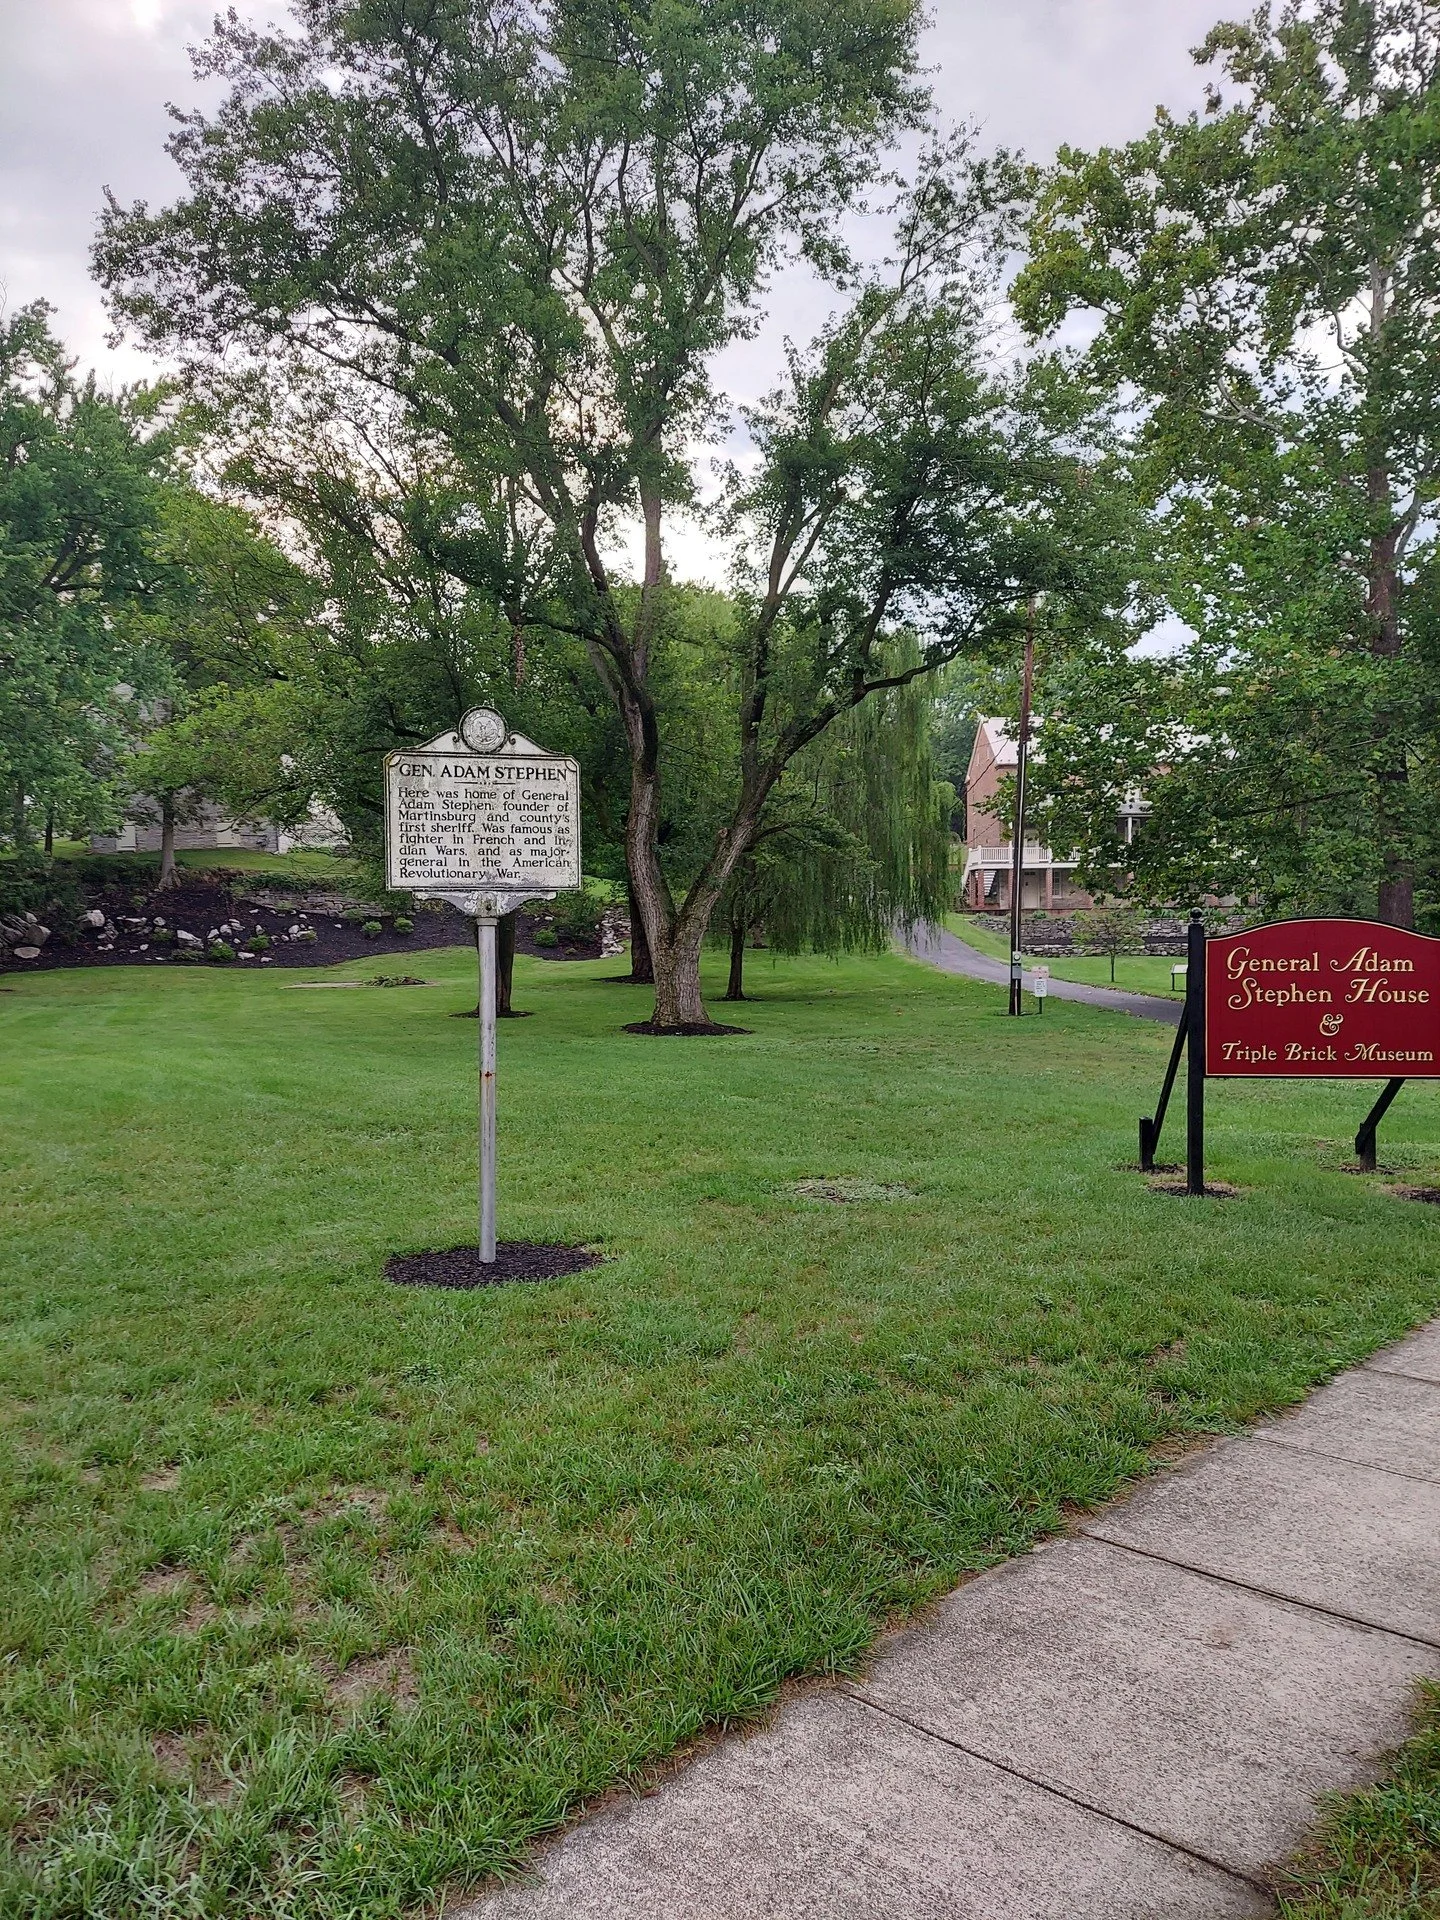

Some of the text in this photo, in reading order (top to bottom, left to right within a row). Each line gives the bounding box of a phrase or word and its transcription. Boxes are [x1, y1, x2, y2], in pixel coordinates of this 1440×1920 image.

[400, 763, 567, 781] GEN. ADAM STEPHEN
[399, 787, 429, 798] Here
[465, 789, 496, 799] home
[503, 790, 515, 799] of
[522, 790, 568, 801] General
[399, 800, 434, 809] Adam
[503, 802, 549, 811] founder
[557, 802, 568, 812] of
[399, 811, 569, 825] Martinsburg and county's
[399, 822, 426, 832] first
[431, 823, 474, 832] sheriff.
[482, 823, 505, 833] Was
[510, 824, 552, 833] famous
[399, 834, 443, 846] fighter
[453, 834, 463, 844] in
[473, 835, 515, 844] French
[524, 836, 545, 845] and
[399, 845, 426, 854] dian
[478, 847, 500, 856] and
[530, 848, 570, 858] major-
[400, 857, 569, 867] general in the American
[400, 868, 521, 880] Revolutionary War.
[1227, 947, 1414, 979] General Adam
[1228, 978, 1430, 1010] Stephen House
[1319, 1014, 1343, 1036] &
[1222, 1040, 1433, 1063] Triple Brick Museum
